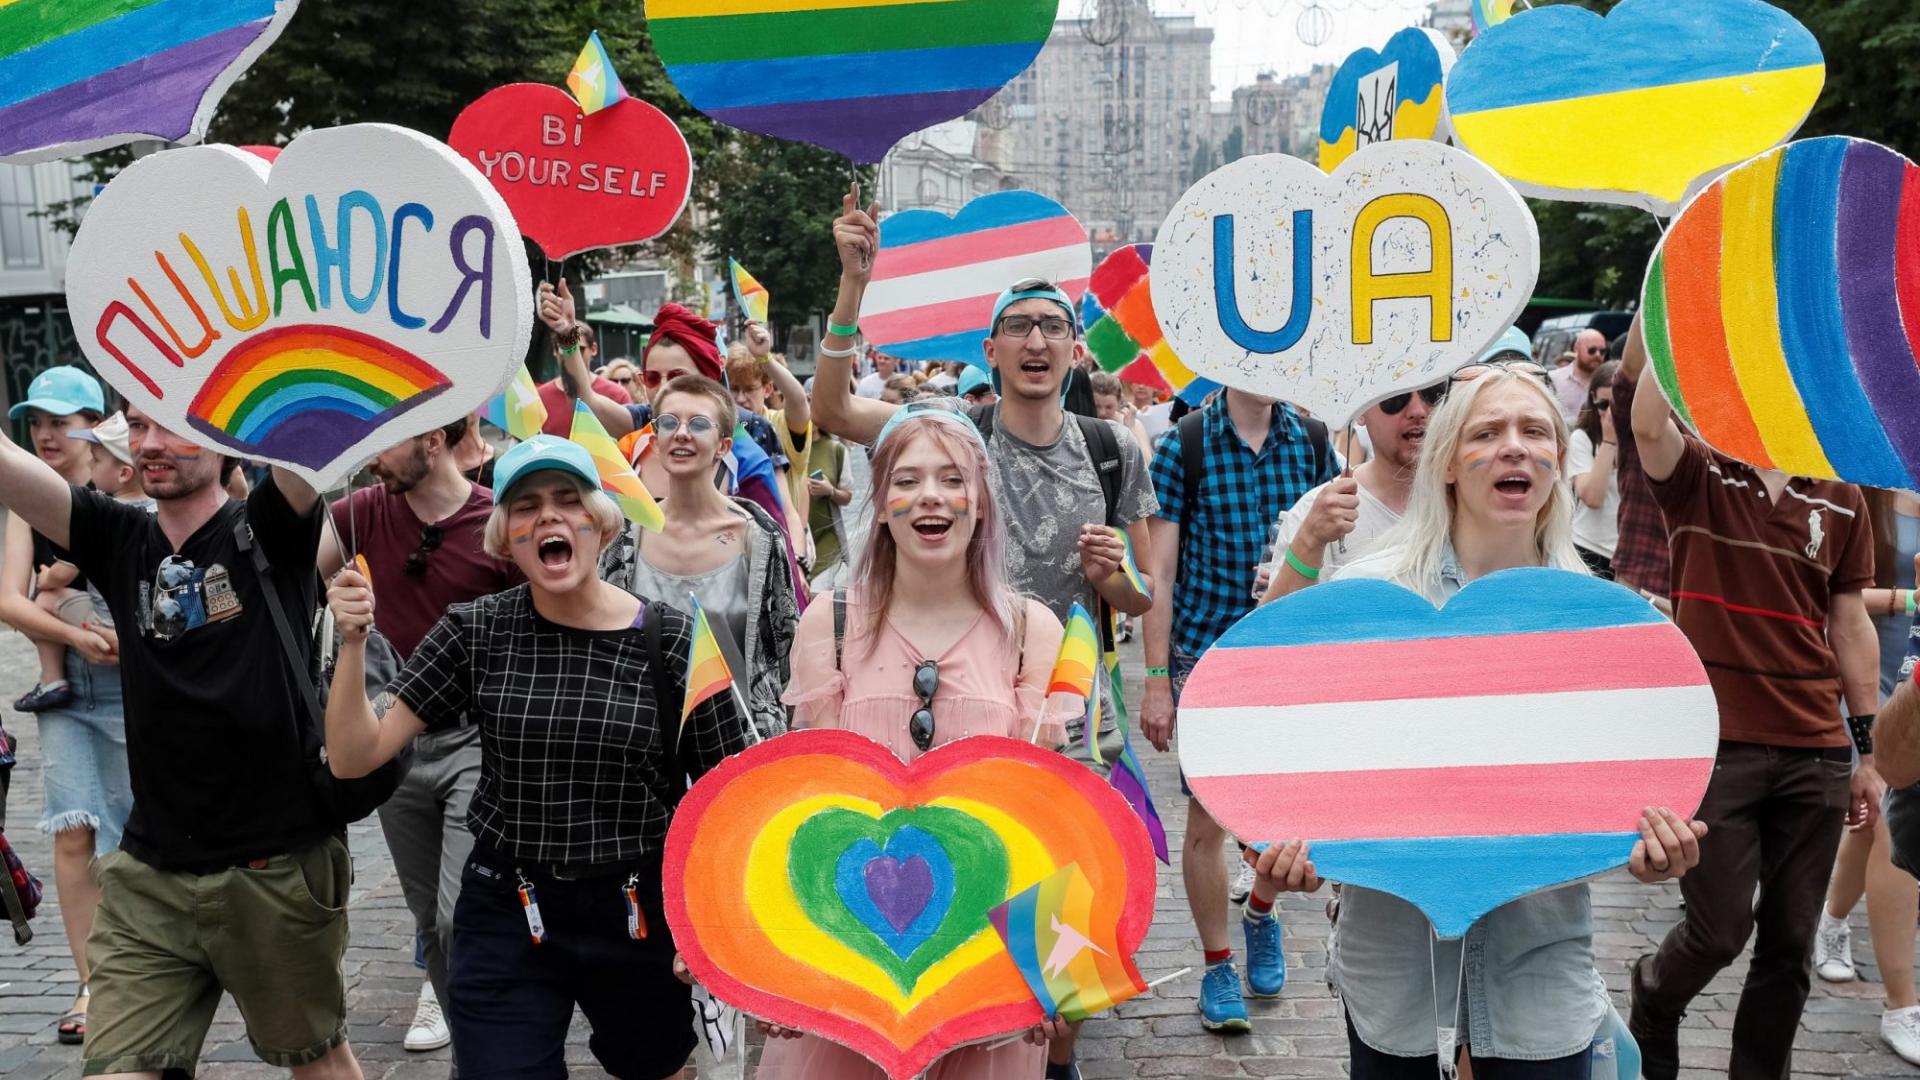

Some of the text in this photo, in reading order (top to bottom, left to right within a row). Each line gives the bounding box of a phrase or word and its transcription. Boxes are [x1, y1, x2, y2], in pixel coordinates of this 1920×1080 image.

[478, 149, 667, 198] YOURSELF
[95, 190, 495, 399] ПИШАЮСЯ
[1213, 192, 1453, 354] UA
